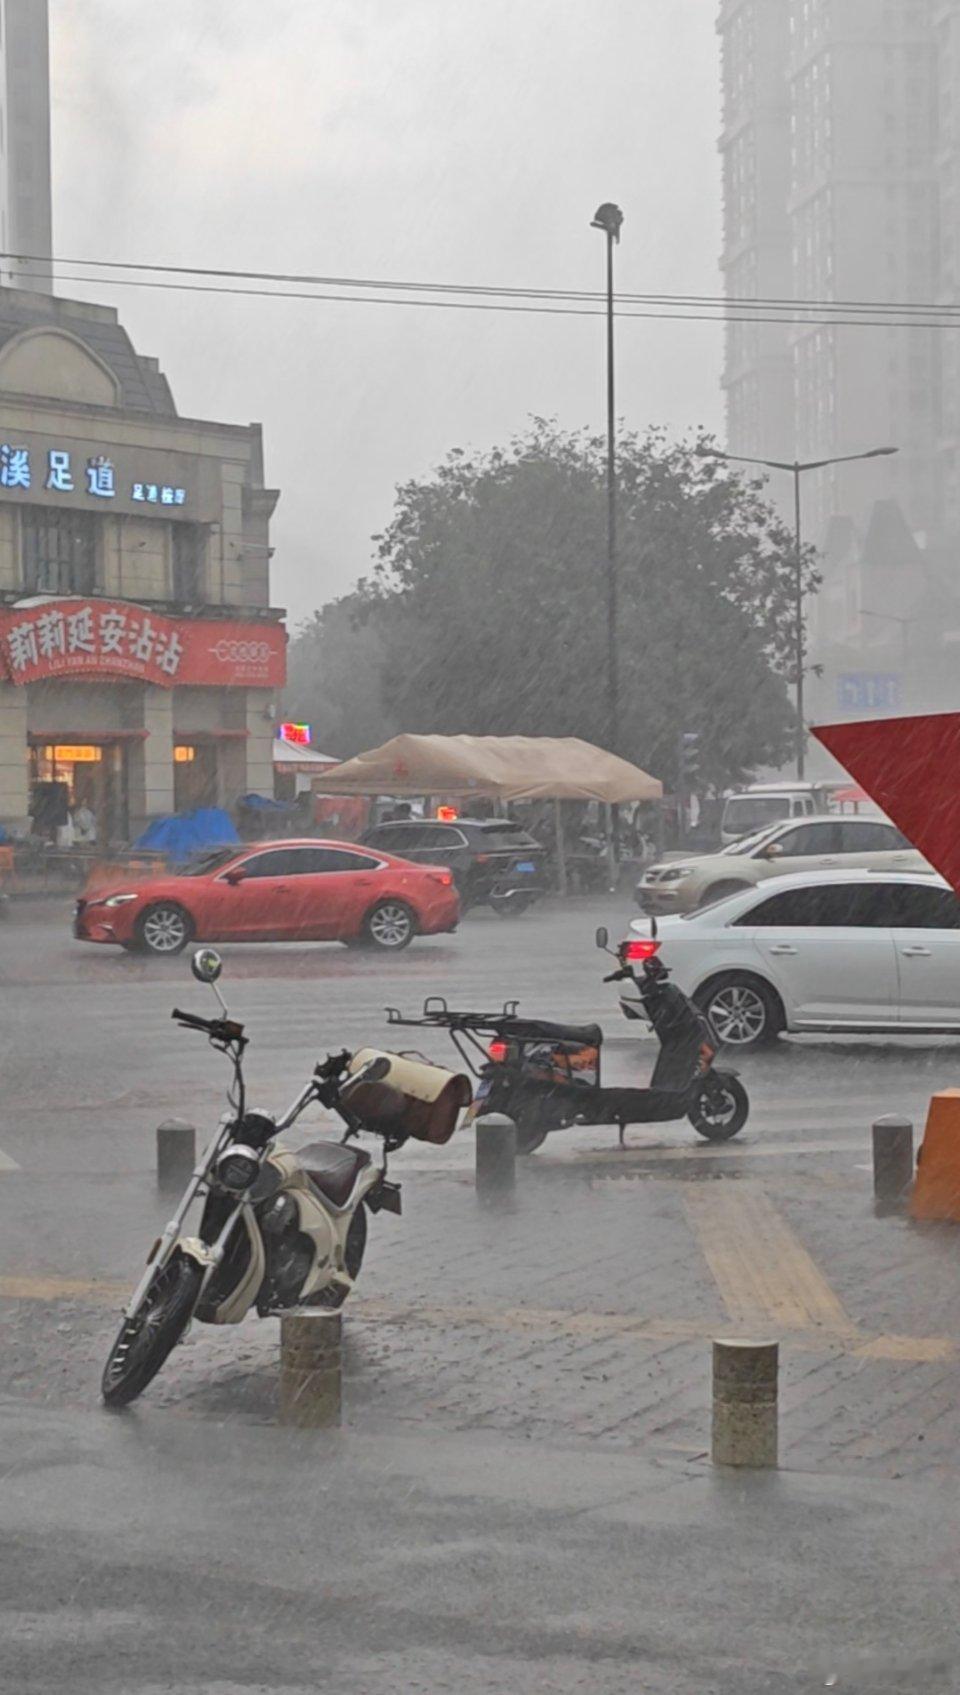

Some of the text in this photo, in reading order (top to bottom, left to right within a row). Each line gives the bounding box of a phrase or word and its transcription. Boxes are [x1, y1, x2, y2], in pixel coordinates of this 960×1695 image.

[6, 606, 184, 675] 莉莉延安沾沾
